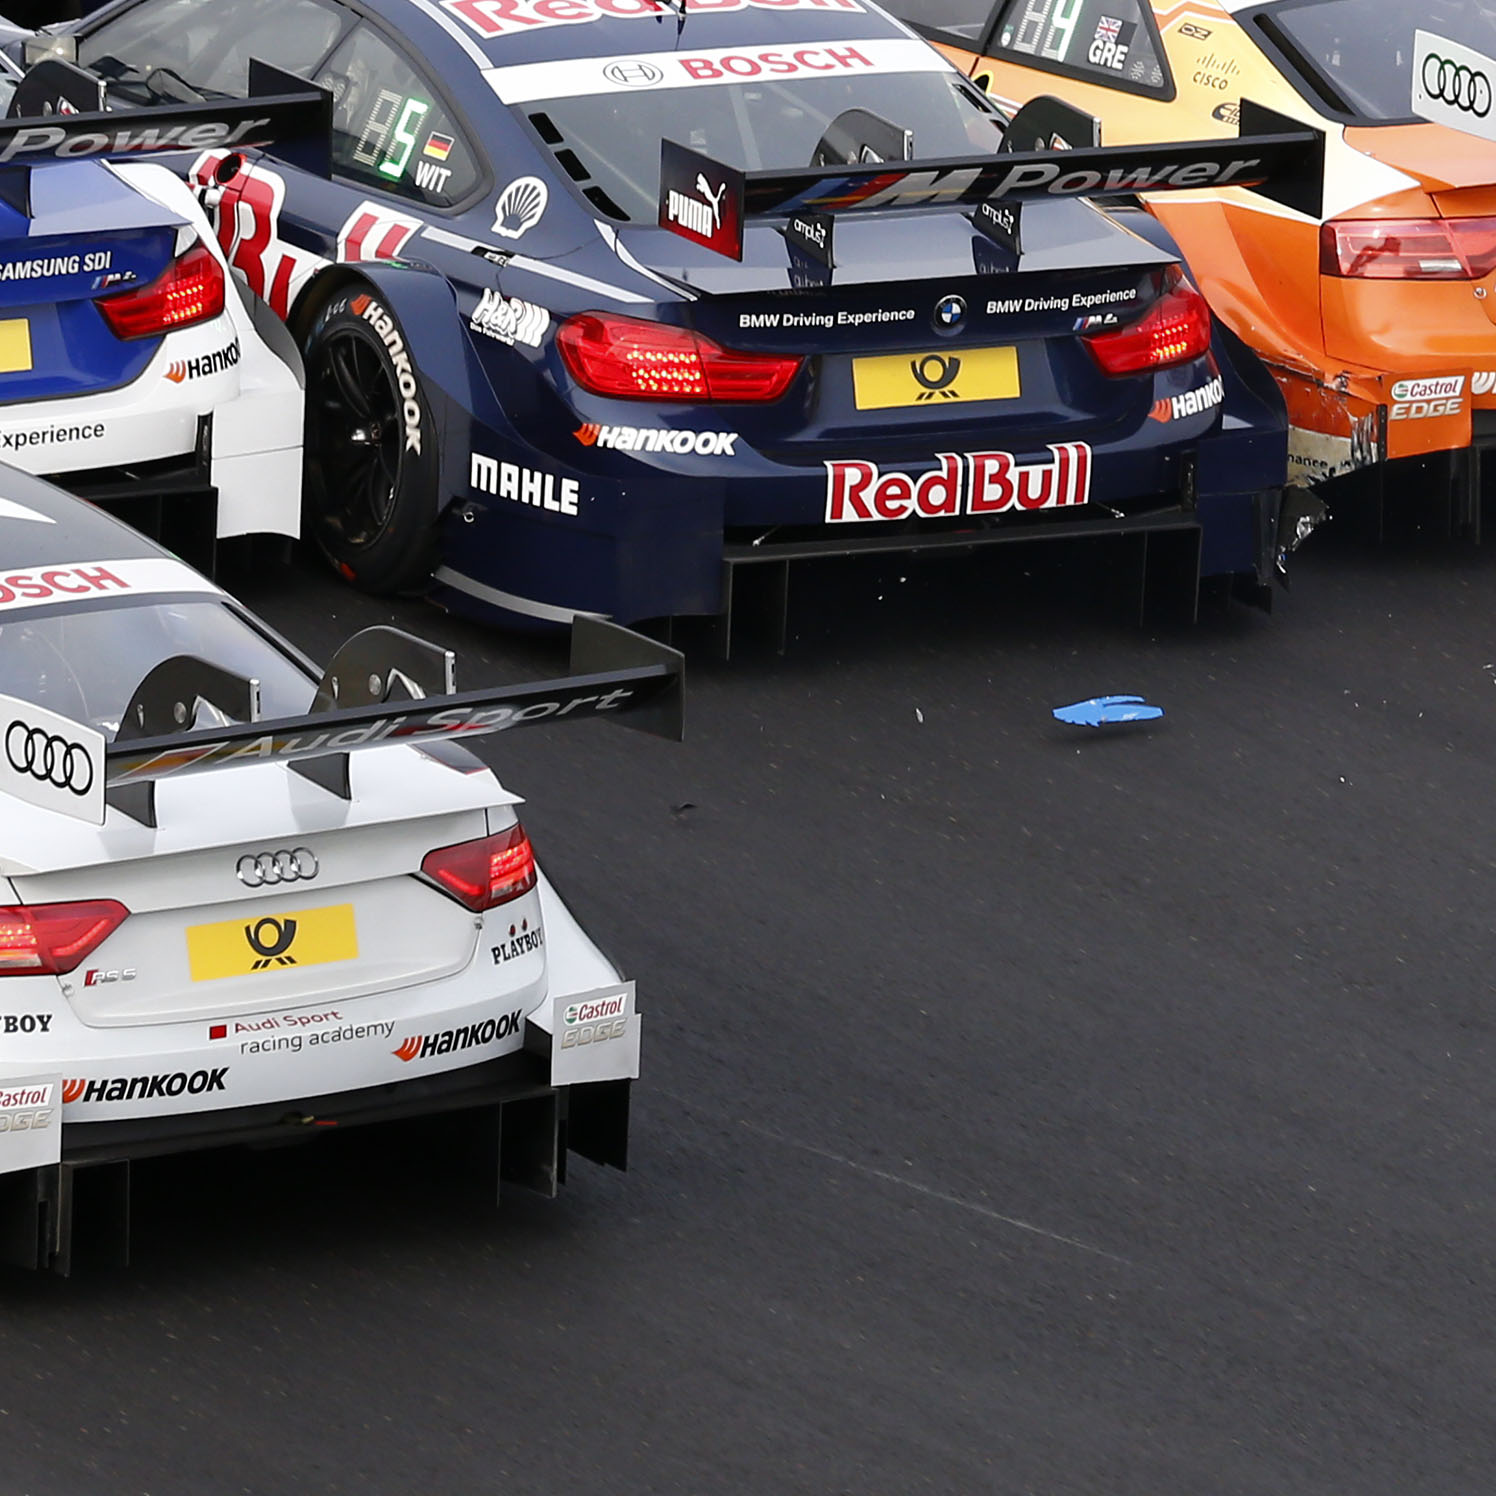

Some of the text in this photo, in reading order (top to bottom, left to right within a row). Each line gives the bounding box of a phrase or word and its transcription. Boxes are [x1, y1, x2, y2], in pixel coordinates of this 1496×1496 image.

[678, 46, 874, 81] BOSCH
[1088, 39, 1129, 71] GRE
[414, 160, 452, 195] WIT
[859, 154, 1262, 207] M Power
[667, 189, 713, 239] PUMA
[82, 251, 112, 272] SDI
[738, 308, 916, 328] BMW Driving Experience
[986, 287, 1137, 315] BMW Driving Experience
[1409, 377, 1459, 399] Castrol
[1389, 397, 1463, 421] EDGE
[470, 451, 580, 516] MAHLE
[823, 440, 1093, 524] Red Bull
[213, 688, 634, 764] Audi Sport
[490, 926, 545, 965] PLAYBOY
[233, 1010, 344, 1035] Audi Sport
[576, 996, 625, 1024] Castrol
[239, 1020, 396, 1057] racing academy
[560, 1017, 627, 1051] EDGE
